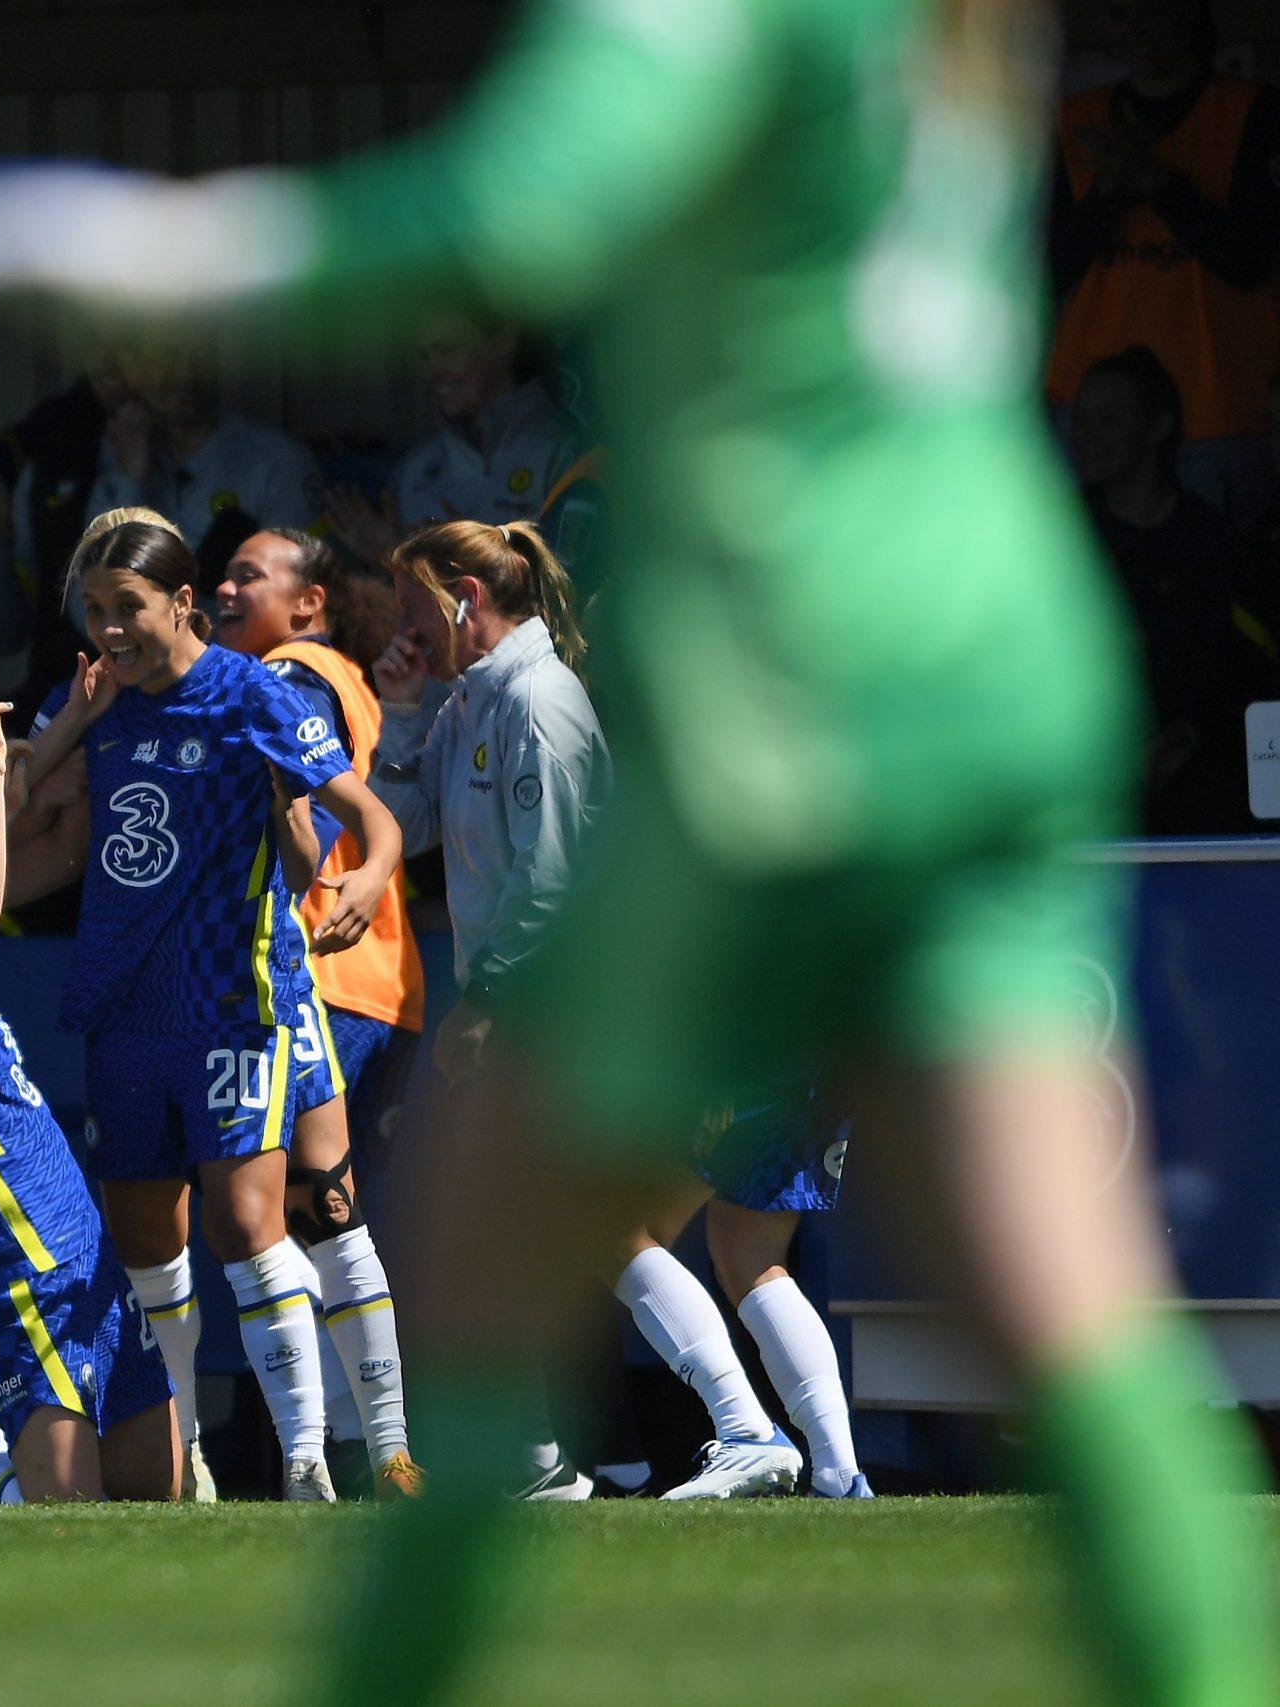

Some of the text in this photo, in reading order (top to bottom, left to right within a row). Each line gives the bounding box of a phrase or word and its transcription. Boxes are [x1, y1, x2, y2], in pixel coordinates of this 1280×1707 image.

[101, 781, 179, 888] 3
[206, 1048, 269, 1110] 20
[264, 1347, 302, 1361] CFC
[359, 1359, 393, 1372] CFC
